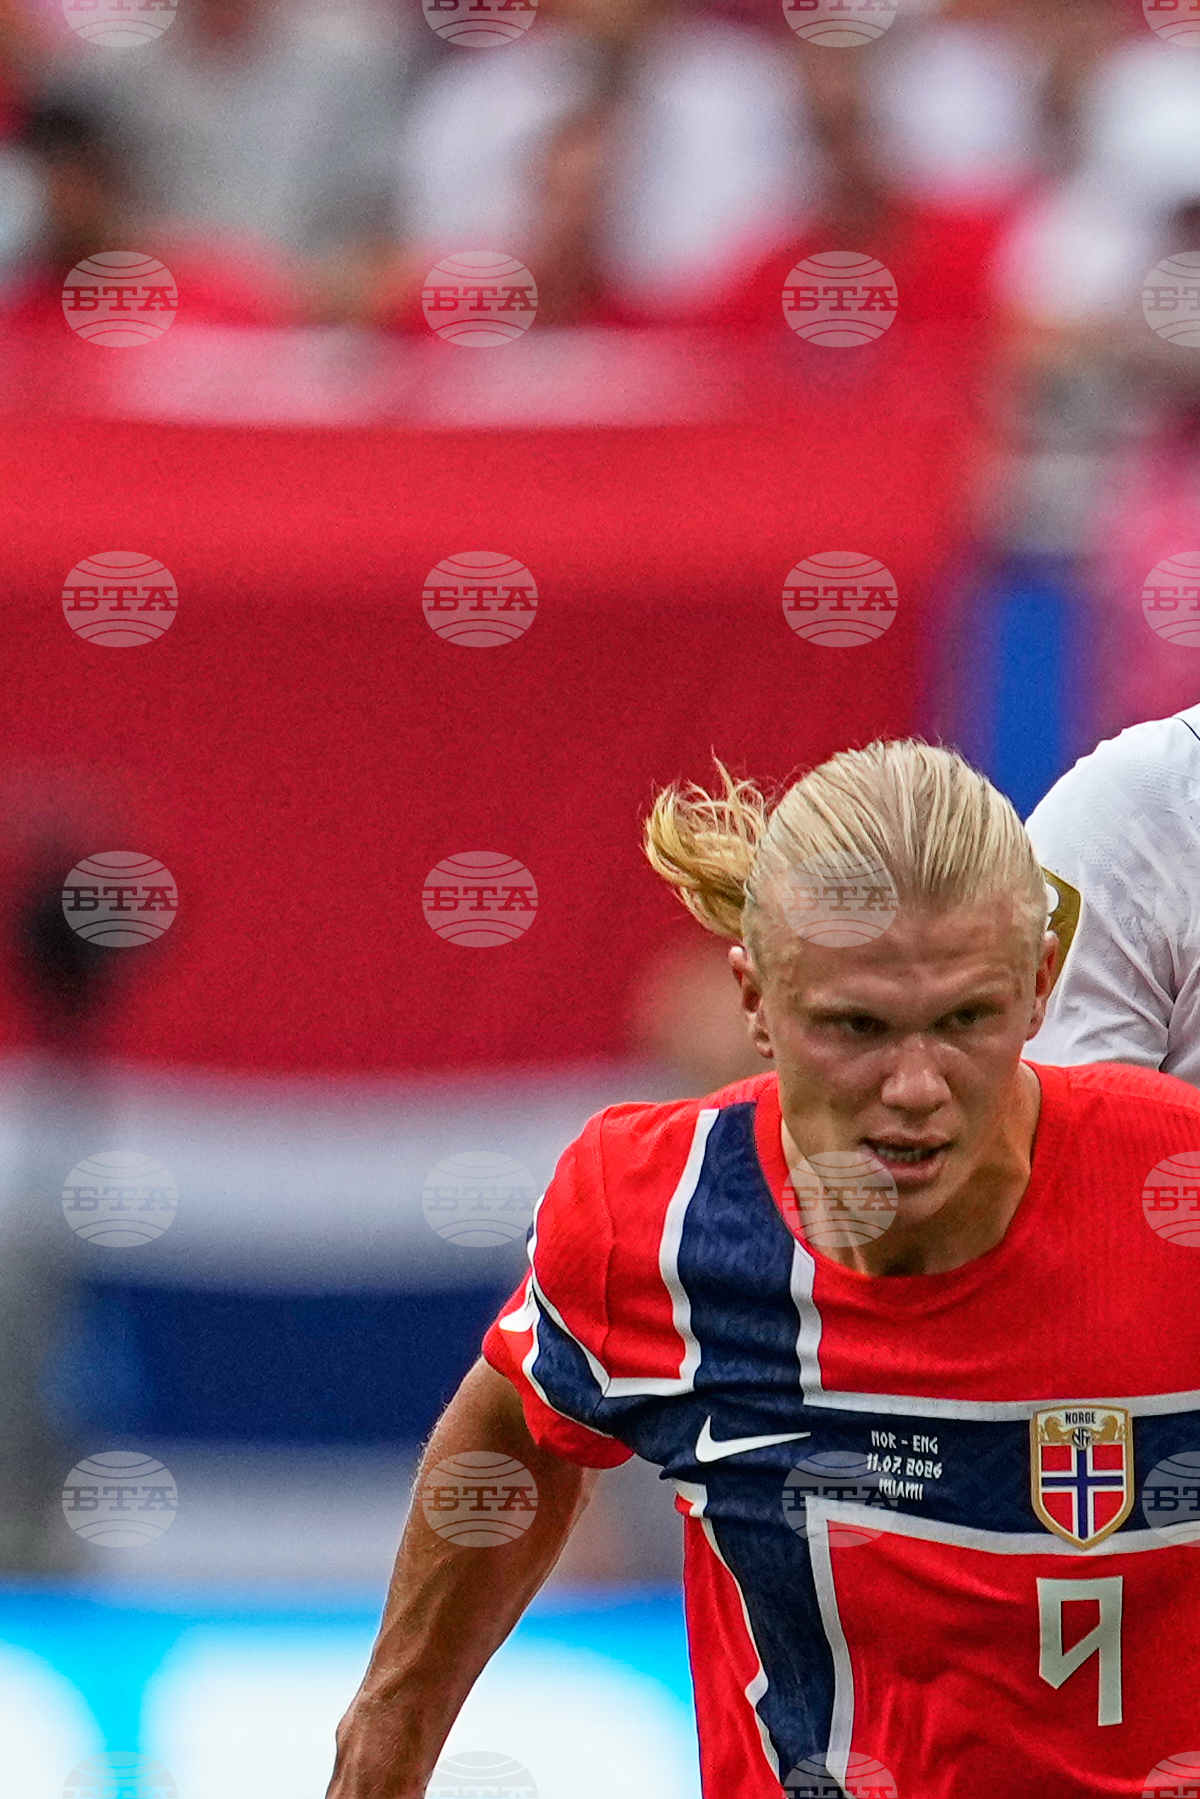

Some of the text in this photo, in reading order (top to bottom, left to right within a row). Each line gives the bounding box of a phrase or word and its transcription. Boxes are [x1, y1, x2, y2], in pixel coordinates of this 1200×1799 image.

[1065, 1411, 1097, 1425] NORGE
[871, 1430, 897, 1450] NOR
[912, 1434, 939, 1455] ENG
[878, 1478, 924, 1501] MIAMI
[1036, 1575, 1124, 1727] 9
